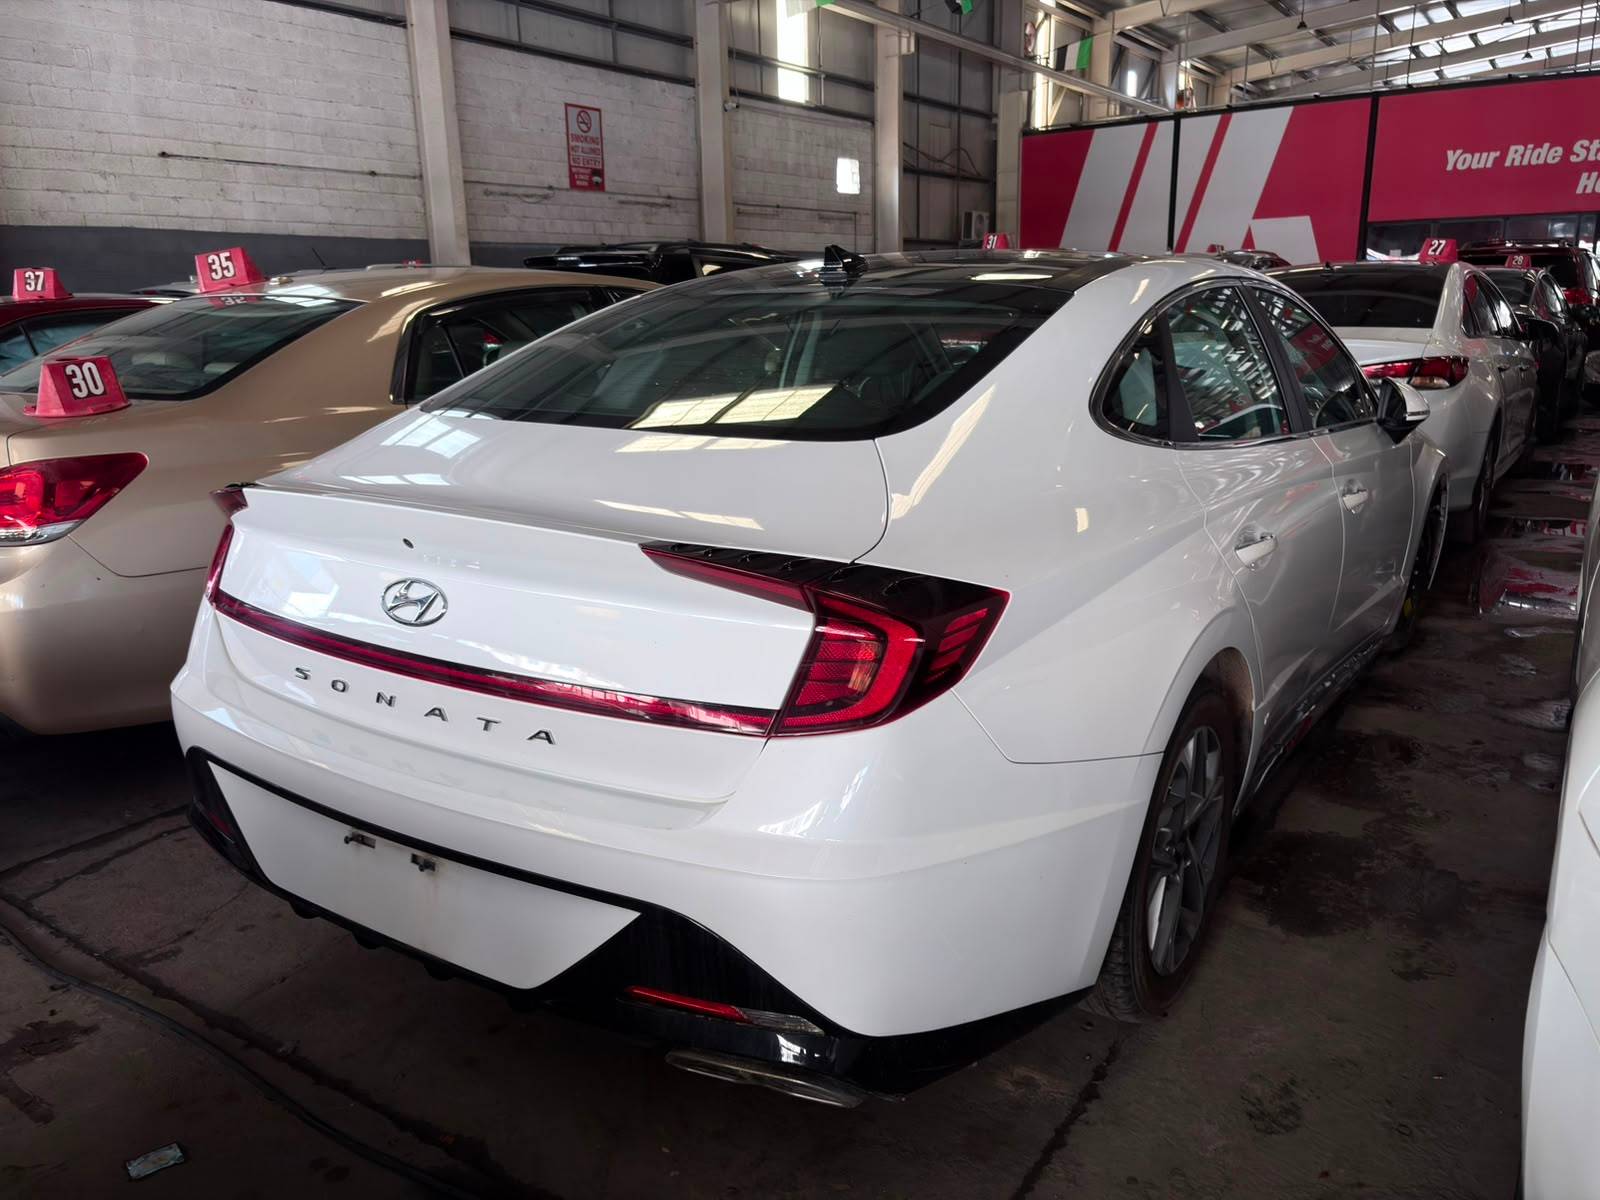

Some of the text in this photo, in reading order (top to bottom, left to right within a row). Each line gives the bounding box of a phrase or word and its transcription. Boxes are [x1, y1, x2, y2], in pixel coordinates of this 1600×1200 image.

[570, 133, 600, 145] SMOKING
[582, 158, 600, 167] ENTRY
[1446, 149, 1500, 171] Your
[1504, 142, 1563, 167] Ride
[986, 234, 998, 249] 31
[1428, 239, 1446, 255] 27
[208, 251, 235, 280] 35
[25, 271, 44, 291] 37
[65, 361, 105, 398] 30
[294, 667, 556, 745] SONATA
